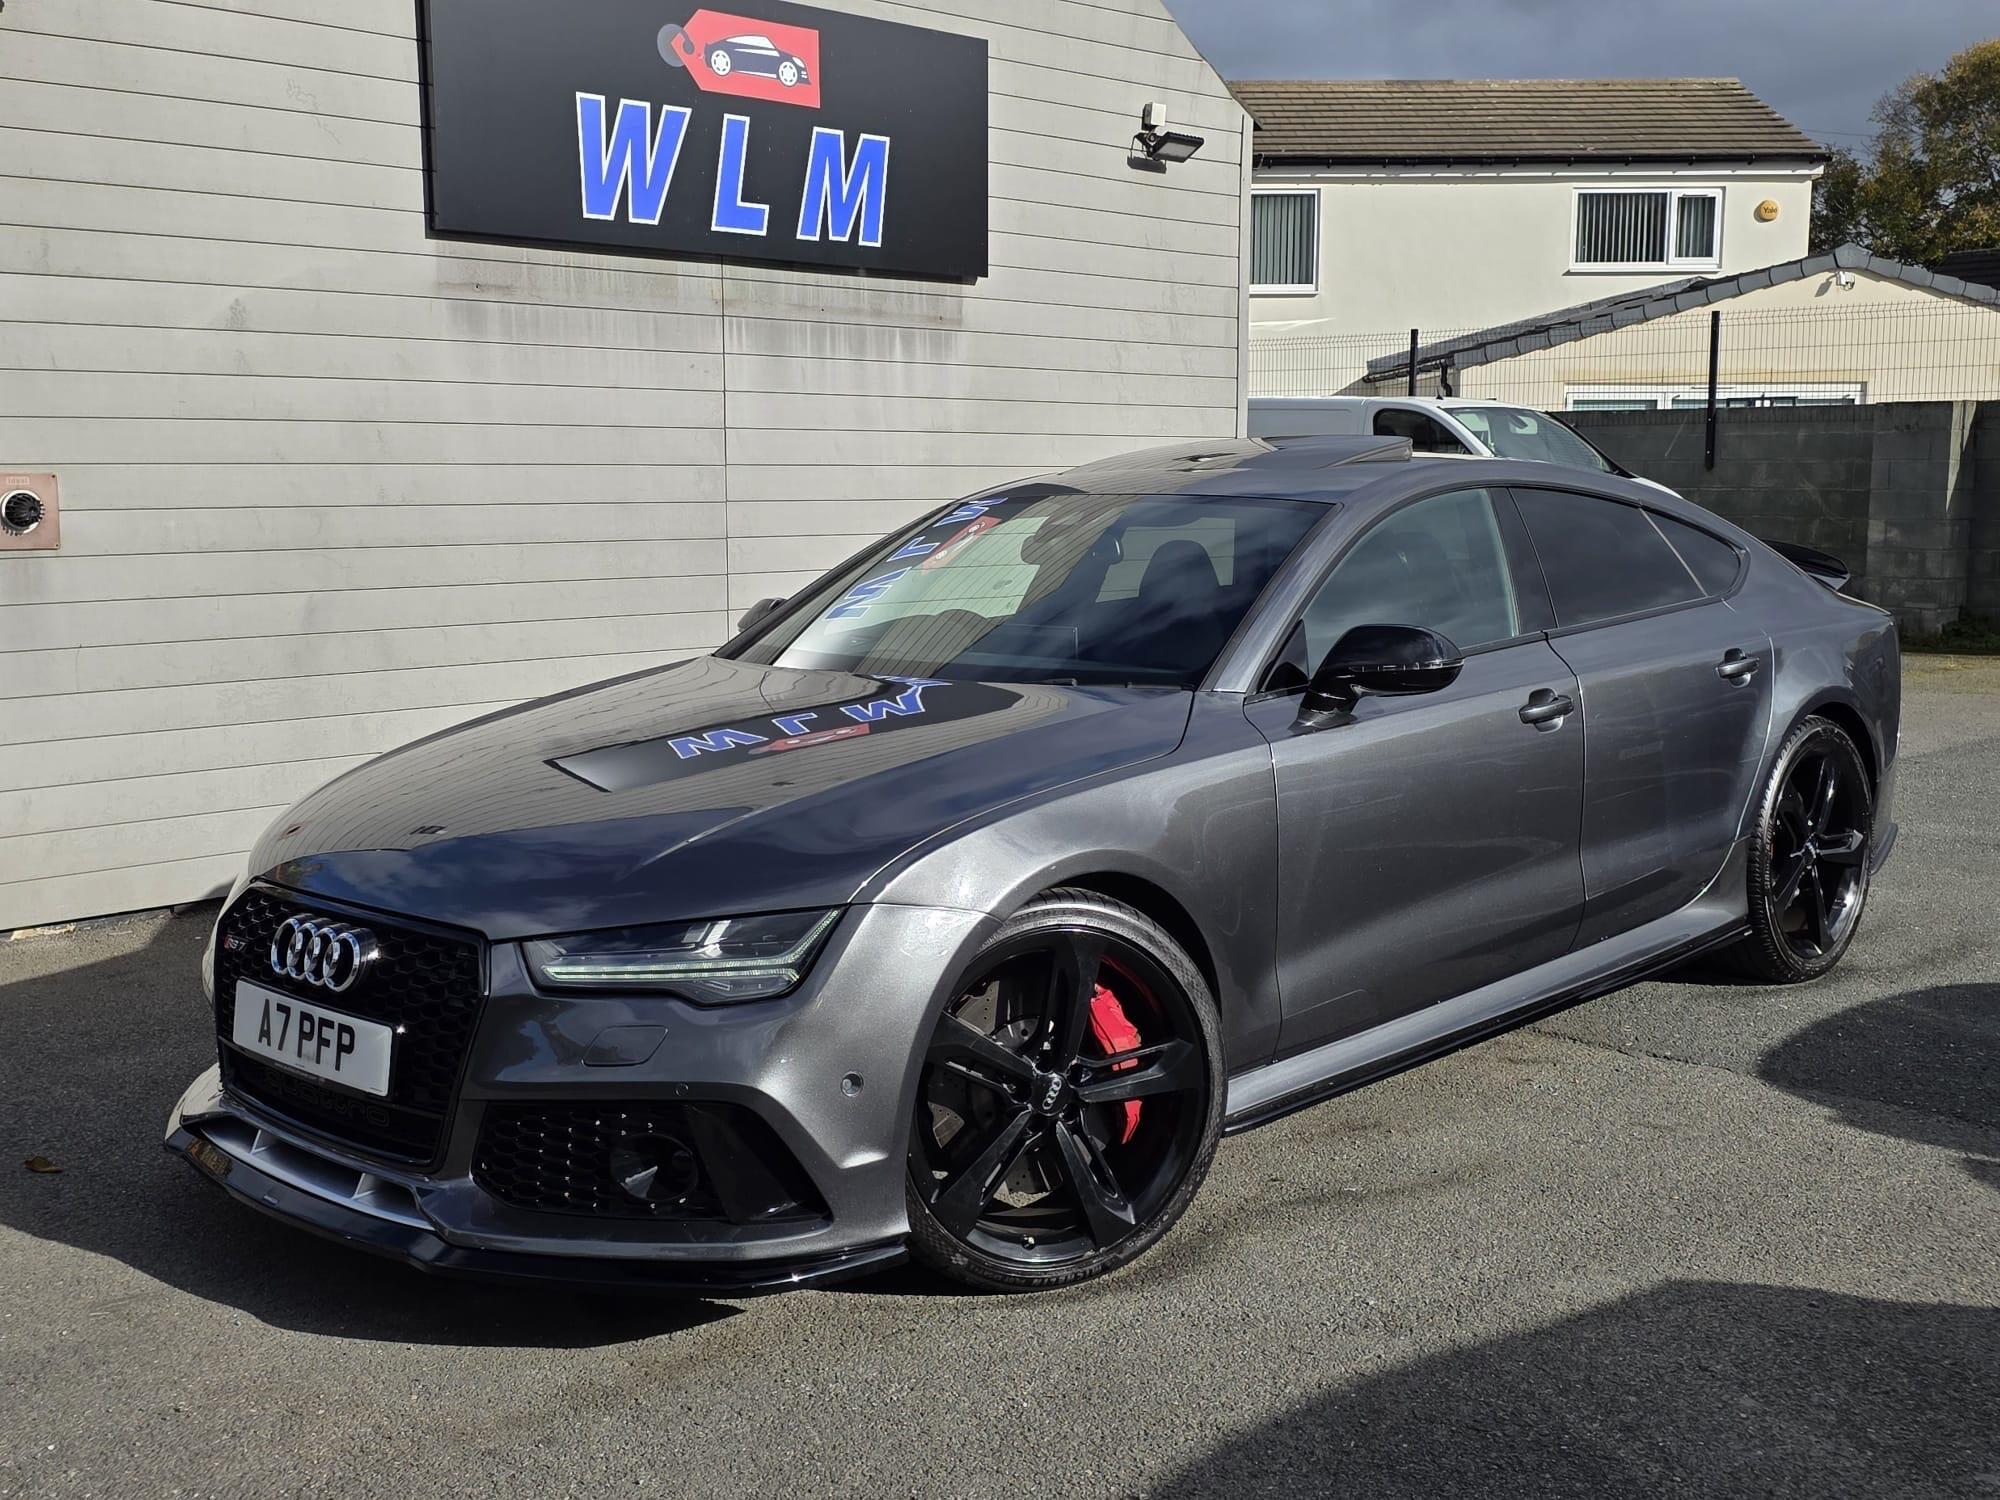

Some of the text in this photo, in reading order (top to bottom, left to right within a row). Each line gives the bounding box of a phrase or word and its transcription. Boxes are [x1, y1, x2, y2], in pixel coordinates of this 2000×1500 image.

[575, 91, 891, 248] WLM
[258, 998, 355, 1072] A7 PFP
